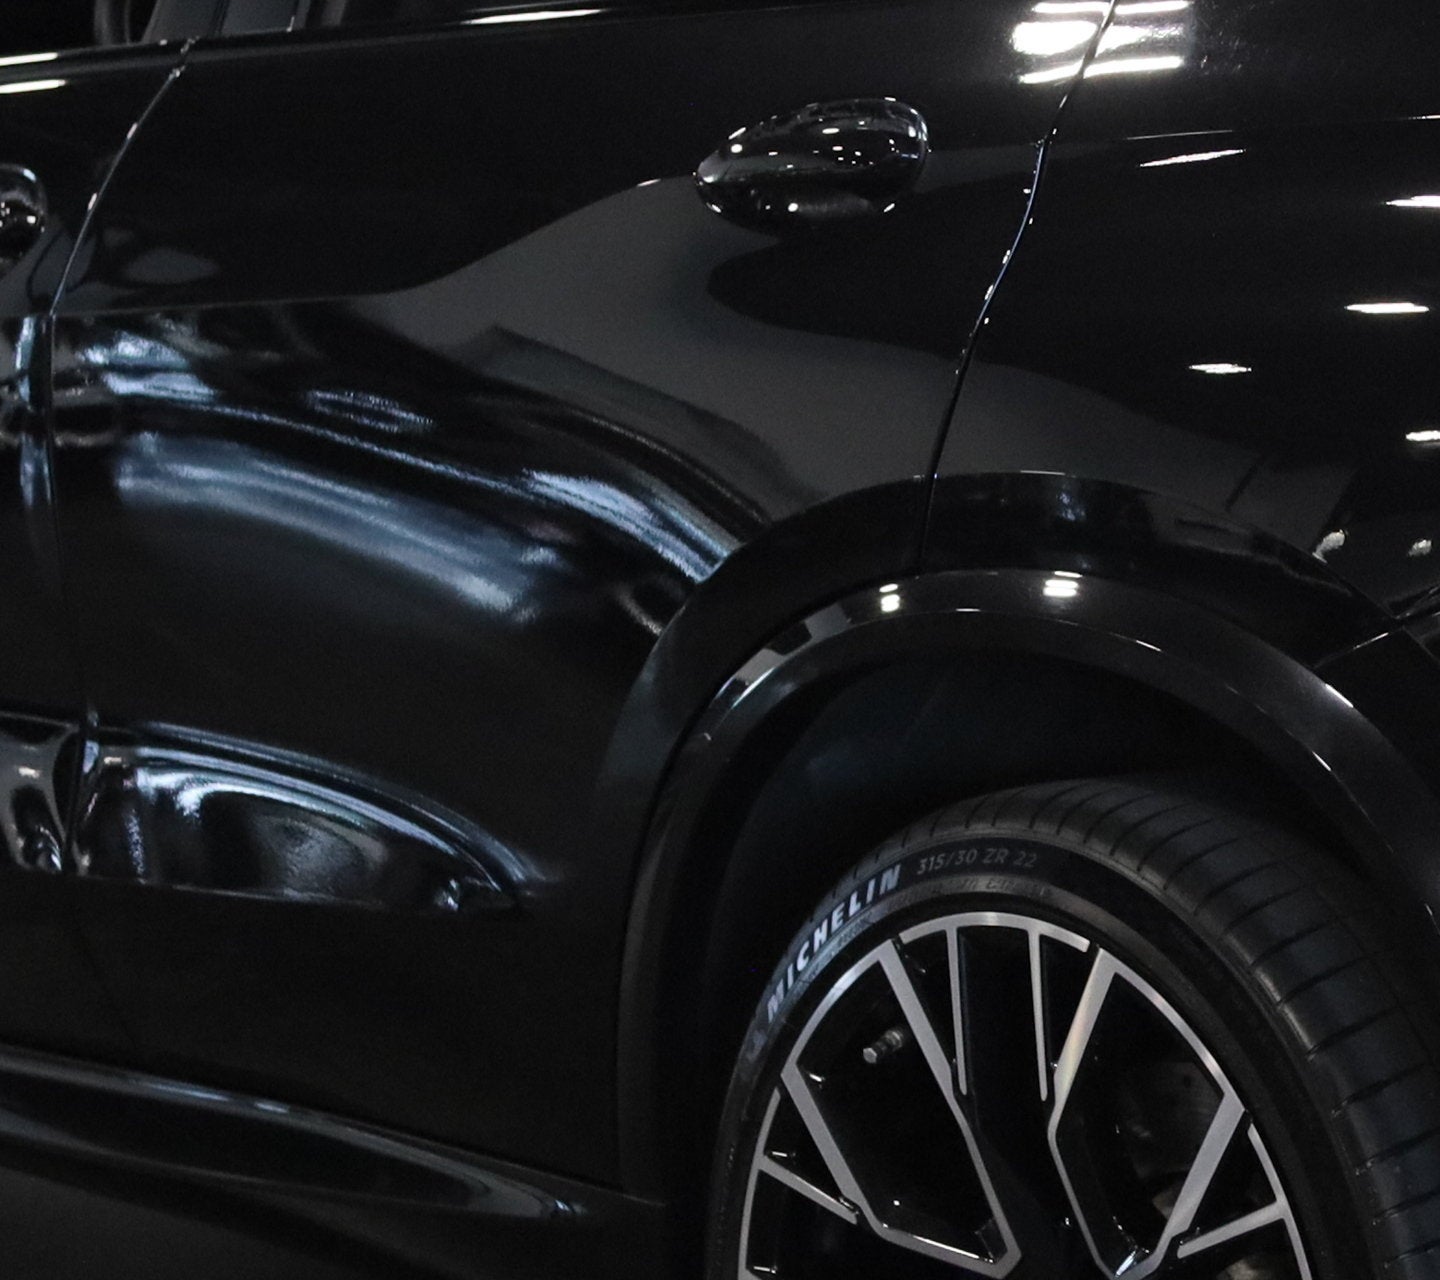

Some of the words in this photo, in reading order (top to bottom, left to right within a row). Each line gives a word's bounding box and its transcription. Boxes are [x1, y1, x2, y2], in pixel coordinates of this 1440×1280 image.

[767, 864, 902, 1024] MICHELIN
[916, 847, 978, 875] 315/30
[982, 846, 1009, 865] ZR
[1012, 849, 1038, 869] 22
